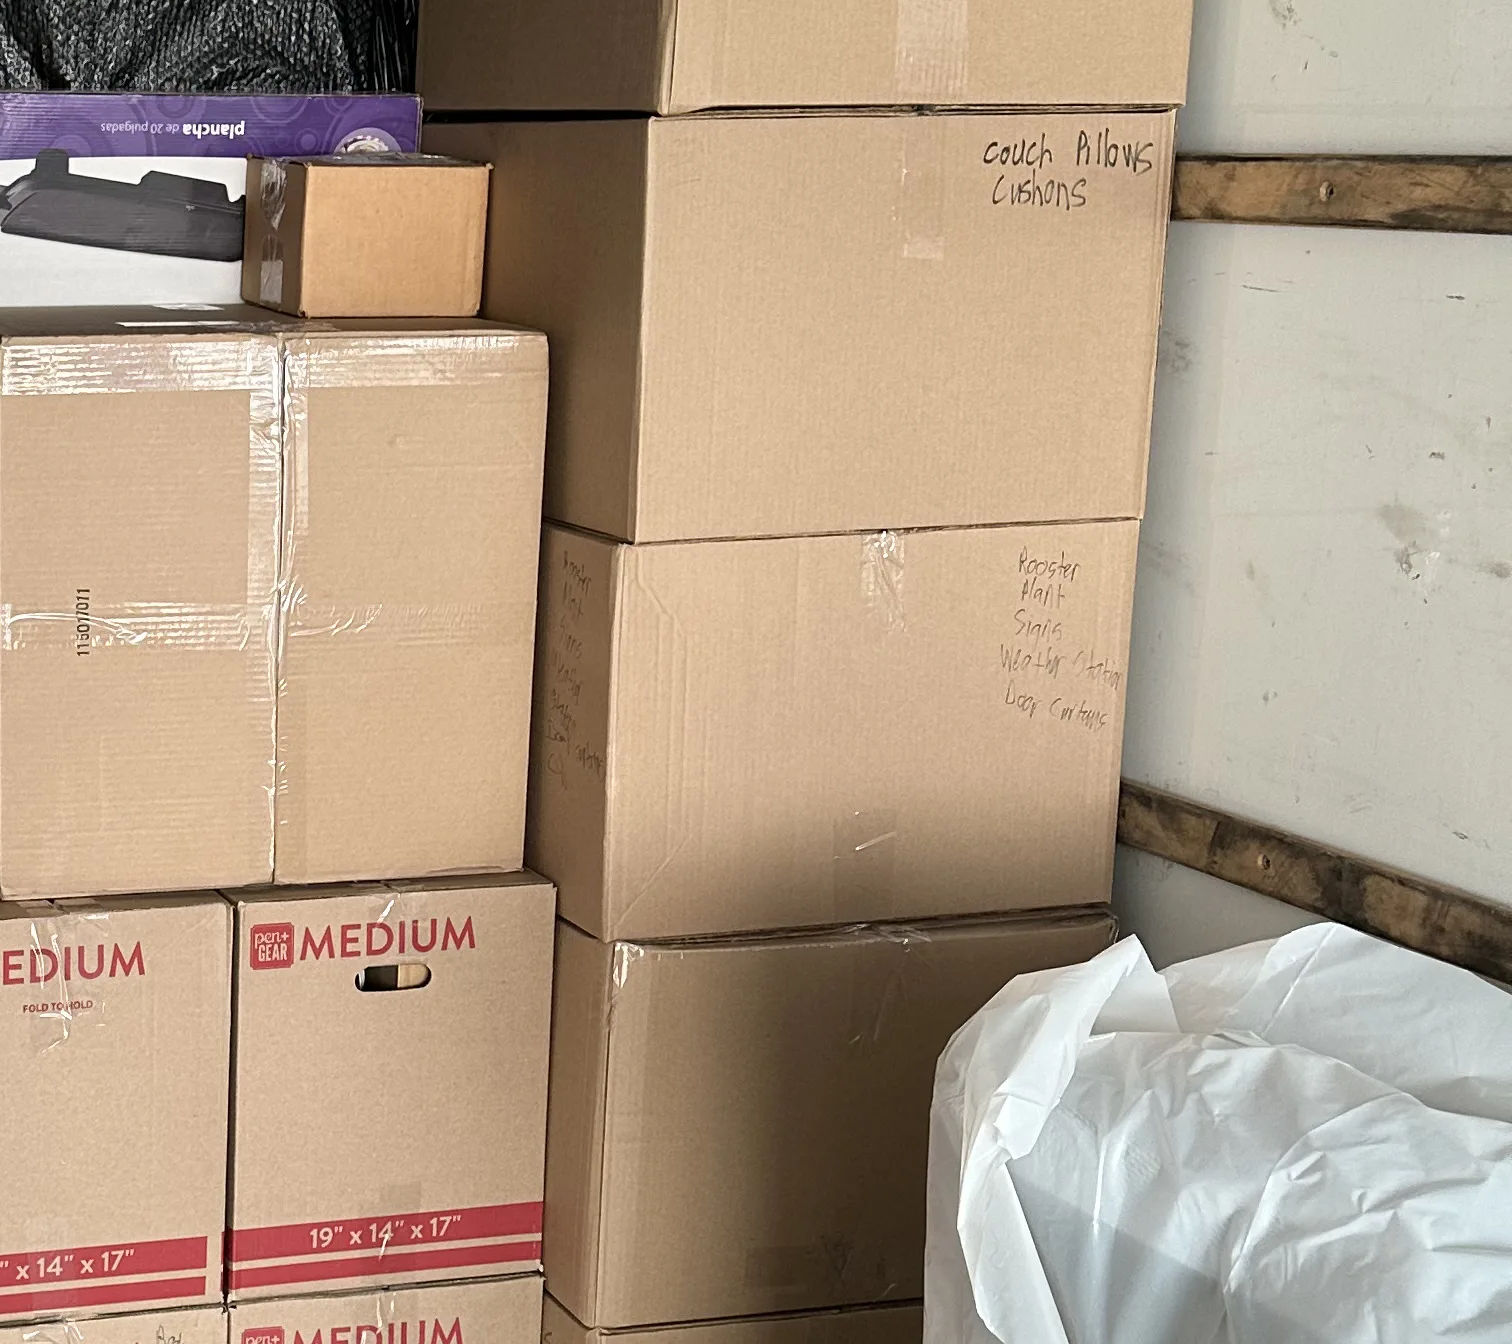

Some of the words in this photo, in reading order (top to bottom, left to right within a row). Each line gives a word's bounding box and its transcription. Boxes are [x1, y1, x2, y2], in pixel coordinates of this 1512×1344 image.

[100, 122, 149, 135] pulgadas
[150, 123, 163, 134] 20
[166, 123, 180, 135] de
[183, 120, 245, 139] plancha
[299, 916, 476, 961] MEDIUM
[258, 942, 288, 962] GEAR
[23, 1002, 49, 1014] FOLD
[51, 1002, 63, 1012] TO
[309, 1225, 344, 1249] 19"
[349, 1230, 363, 1245] x
[369, 1220, 405, 1243] 14"
[410, 1224, 423, 1240] x
[429, 1214, 462, 1237] 17"
[16, 1265, 30, 1280] x
[37, 1254, 74, 1278] 14"
[80, 1259, 94, 1274] x
[101, 1248, 135, 1272] 17"
